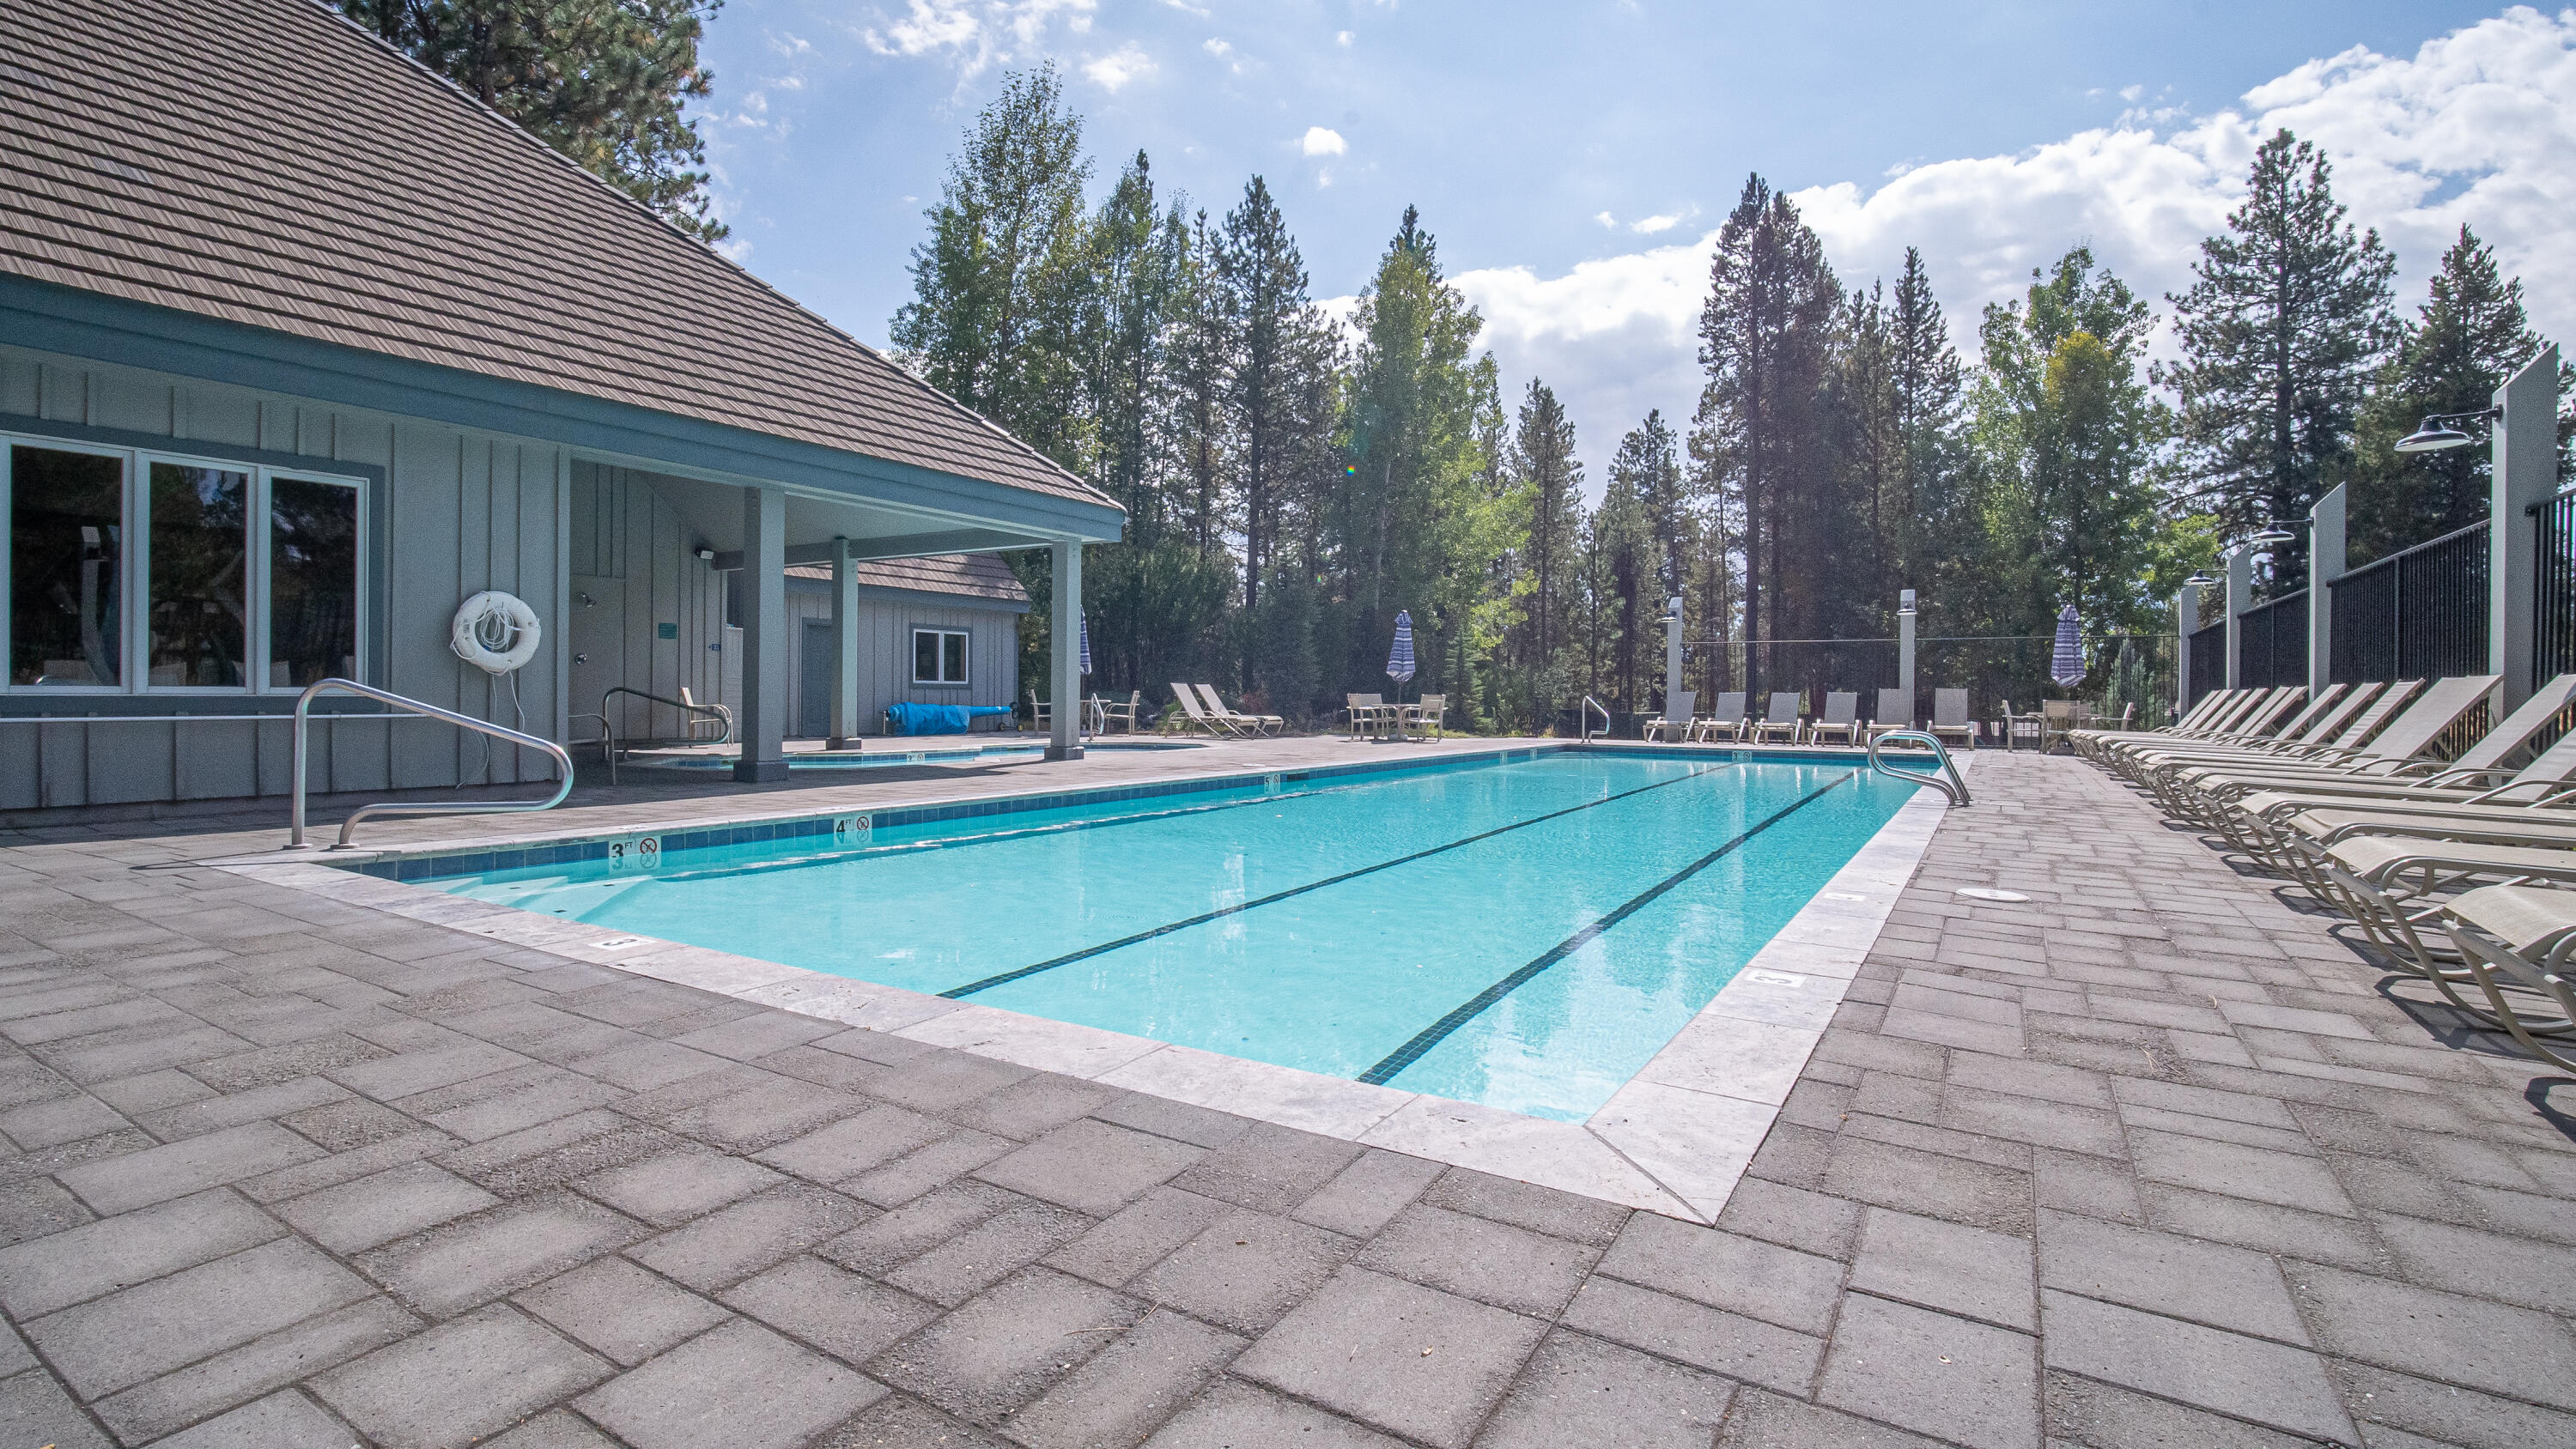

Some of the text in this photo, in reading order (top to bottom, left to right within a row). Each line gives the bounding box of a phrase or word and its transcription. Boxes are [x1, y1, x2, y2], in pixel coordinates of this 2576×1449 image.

[836, 820, 846, 833] 4
[612, 843, 624, 858] 3
[602, 938, 638, 947] 3
[1754, 975, 1793, 984] 3
